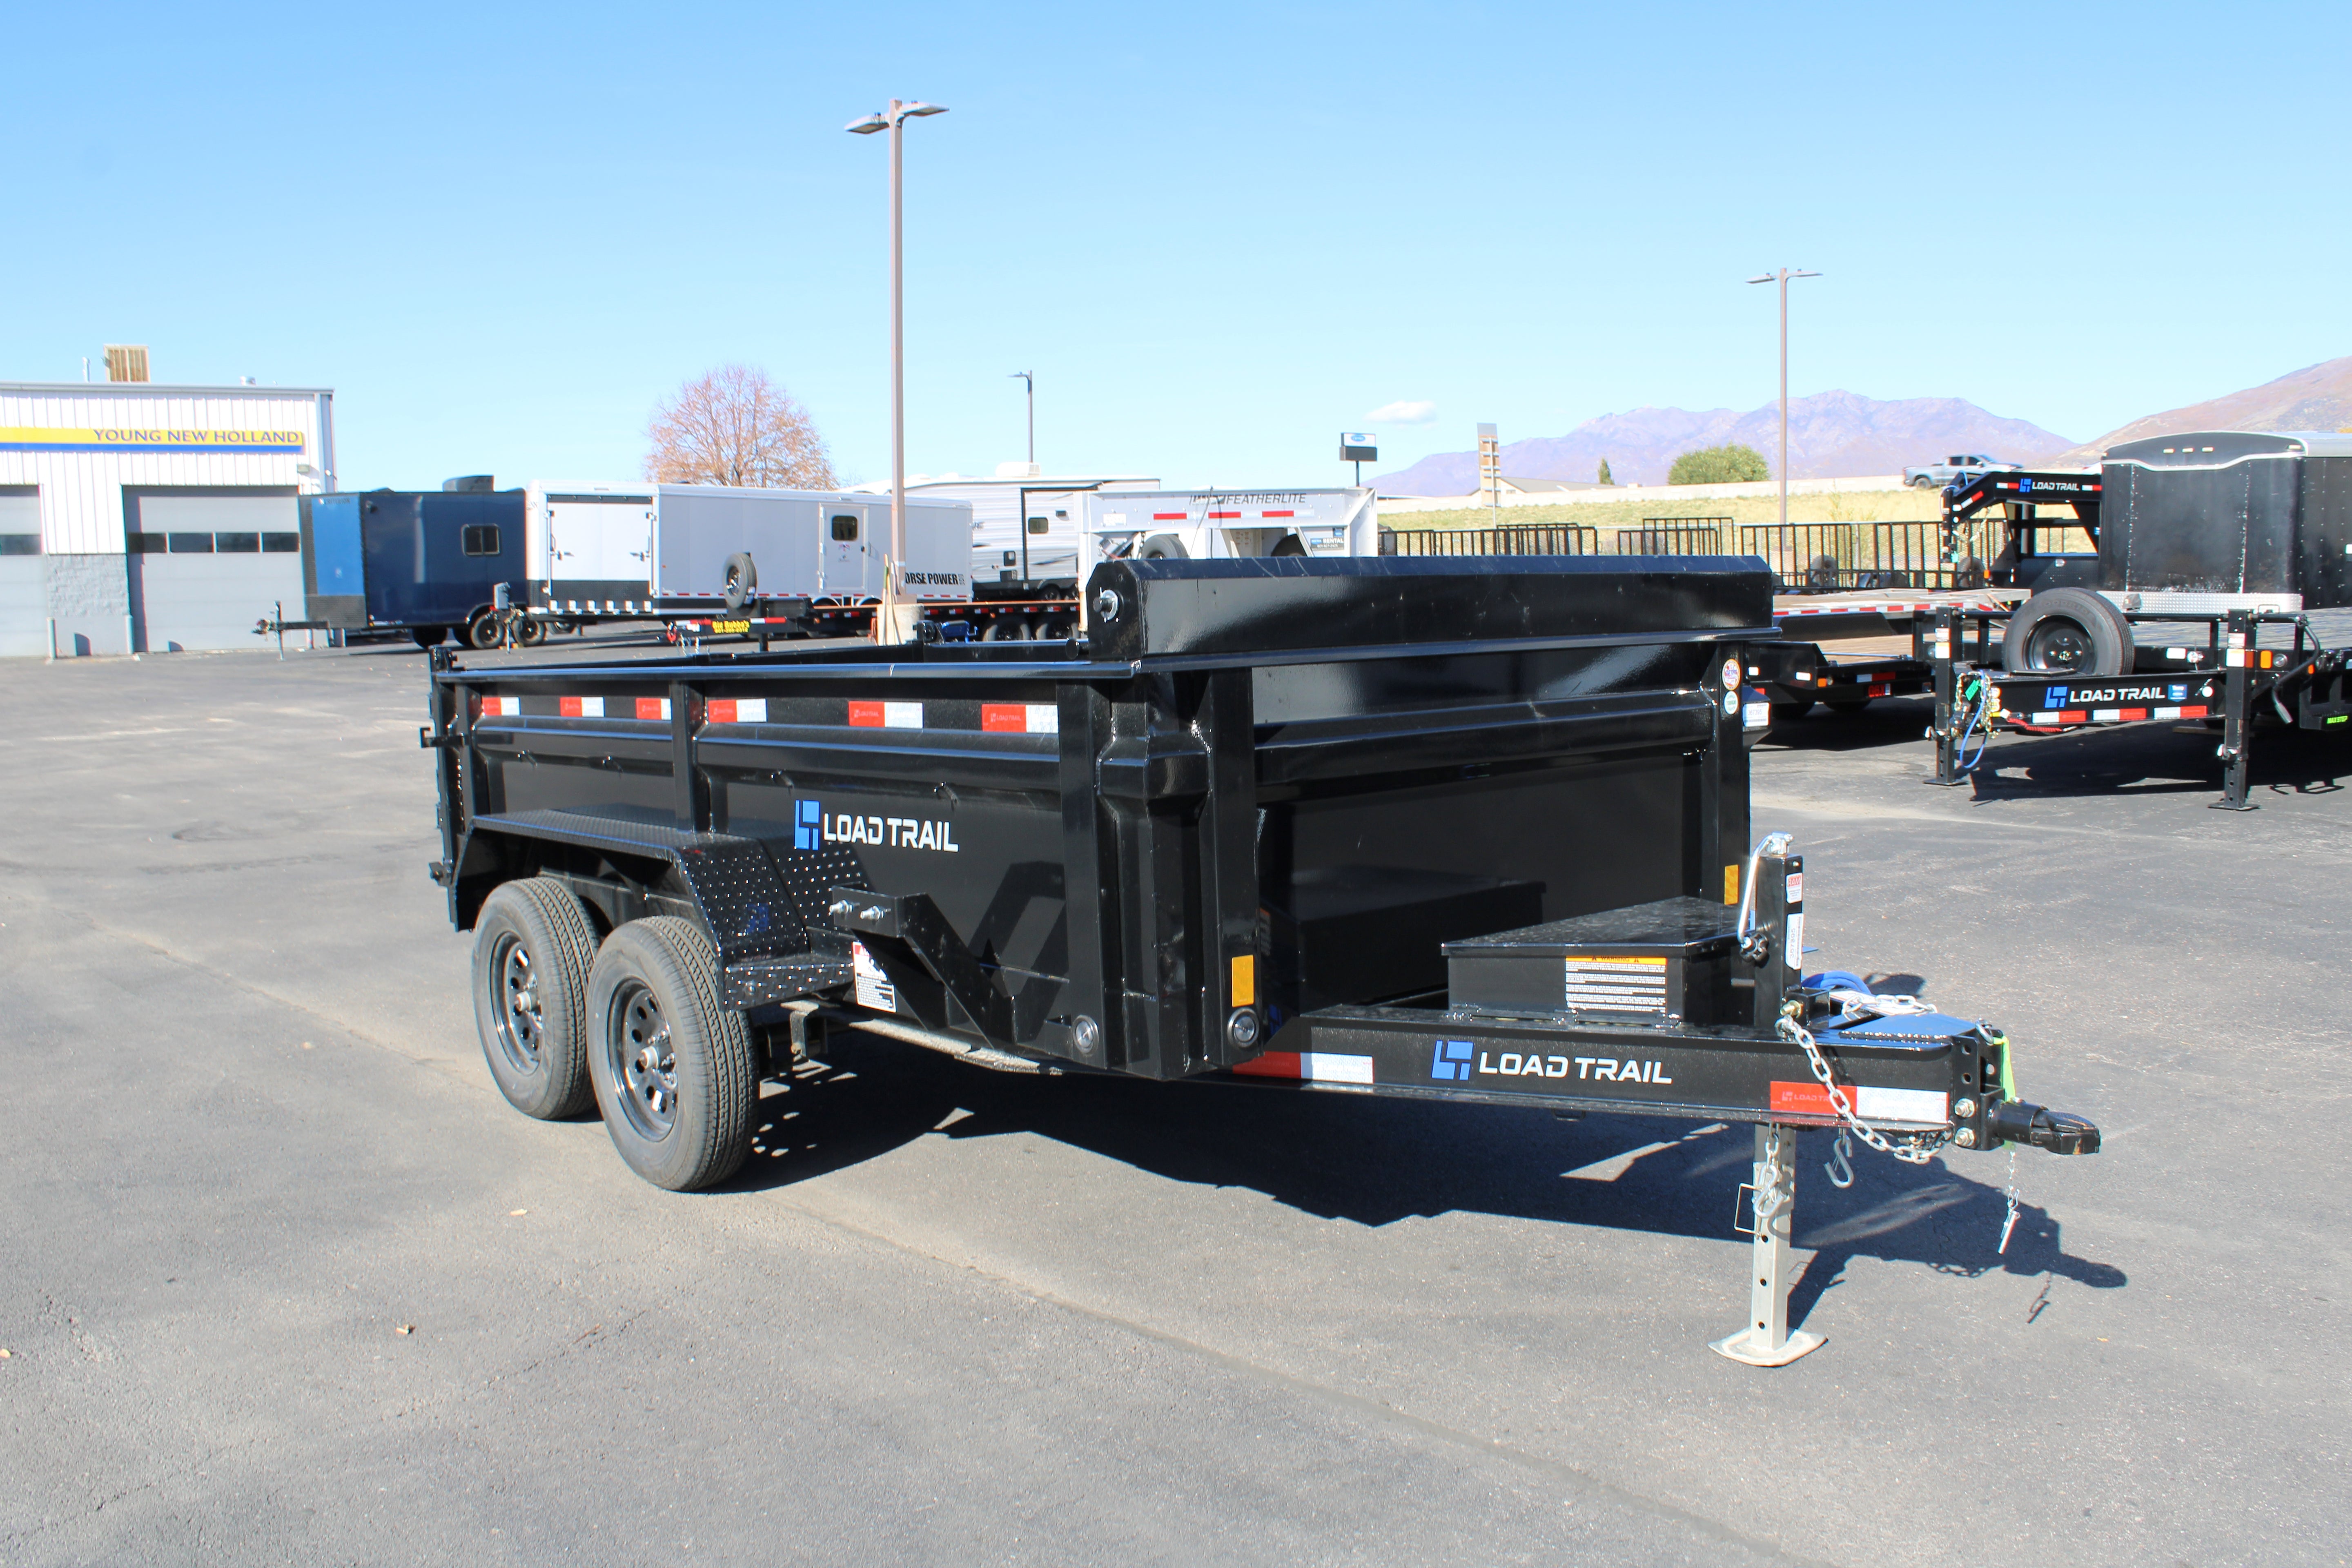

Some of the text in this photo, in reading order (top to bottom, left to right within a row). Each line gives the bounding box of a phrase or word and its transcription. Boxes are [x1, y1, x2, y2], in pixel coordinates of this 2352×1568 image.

[94, 429, 299, 443] YOUNG NEW HOLLAND
[2031, 481, 2080, 491] LOAD TRAIL
[1226, 493, 1307, 505] FEATHERLITE
[905, 572, 927, 584] ORSE
[927, 573, 959, 585] POWER
[2069, 687, 2165, 703] LOAD TRAIL
[824, 813, 959, 853] LOAD TRAIL
[1788, 877, 1801, 887] RAM
[1479, 1051, 1673, 1085] LOAD TRAIL
